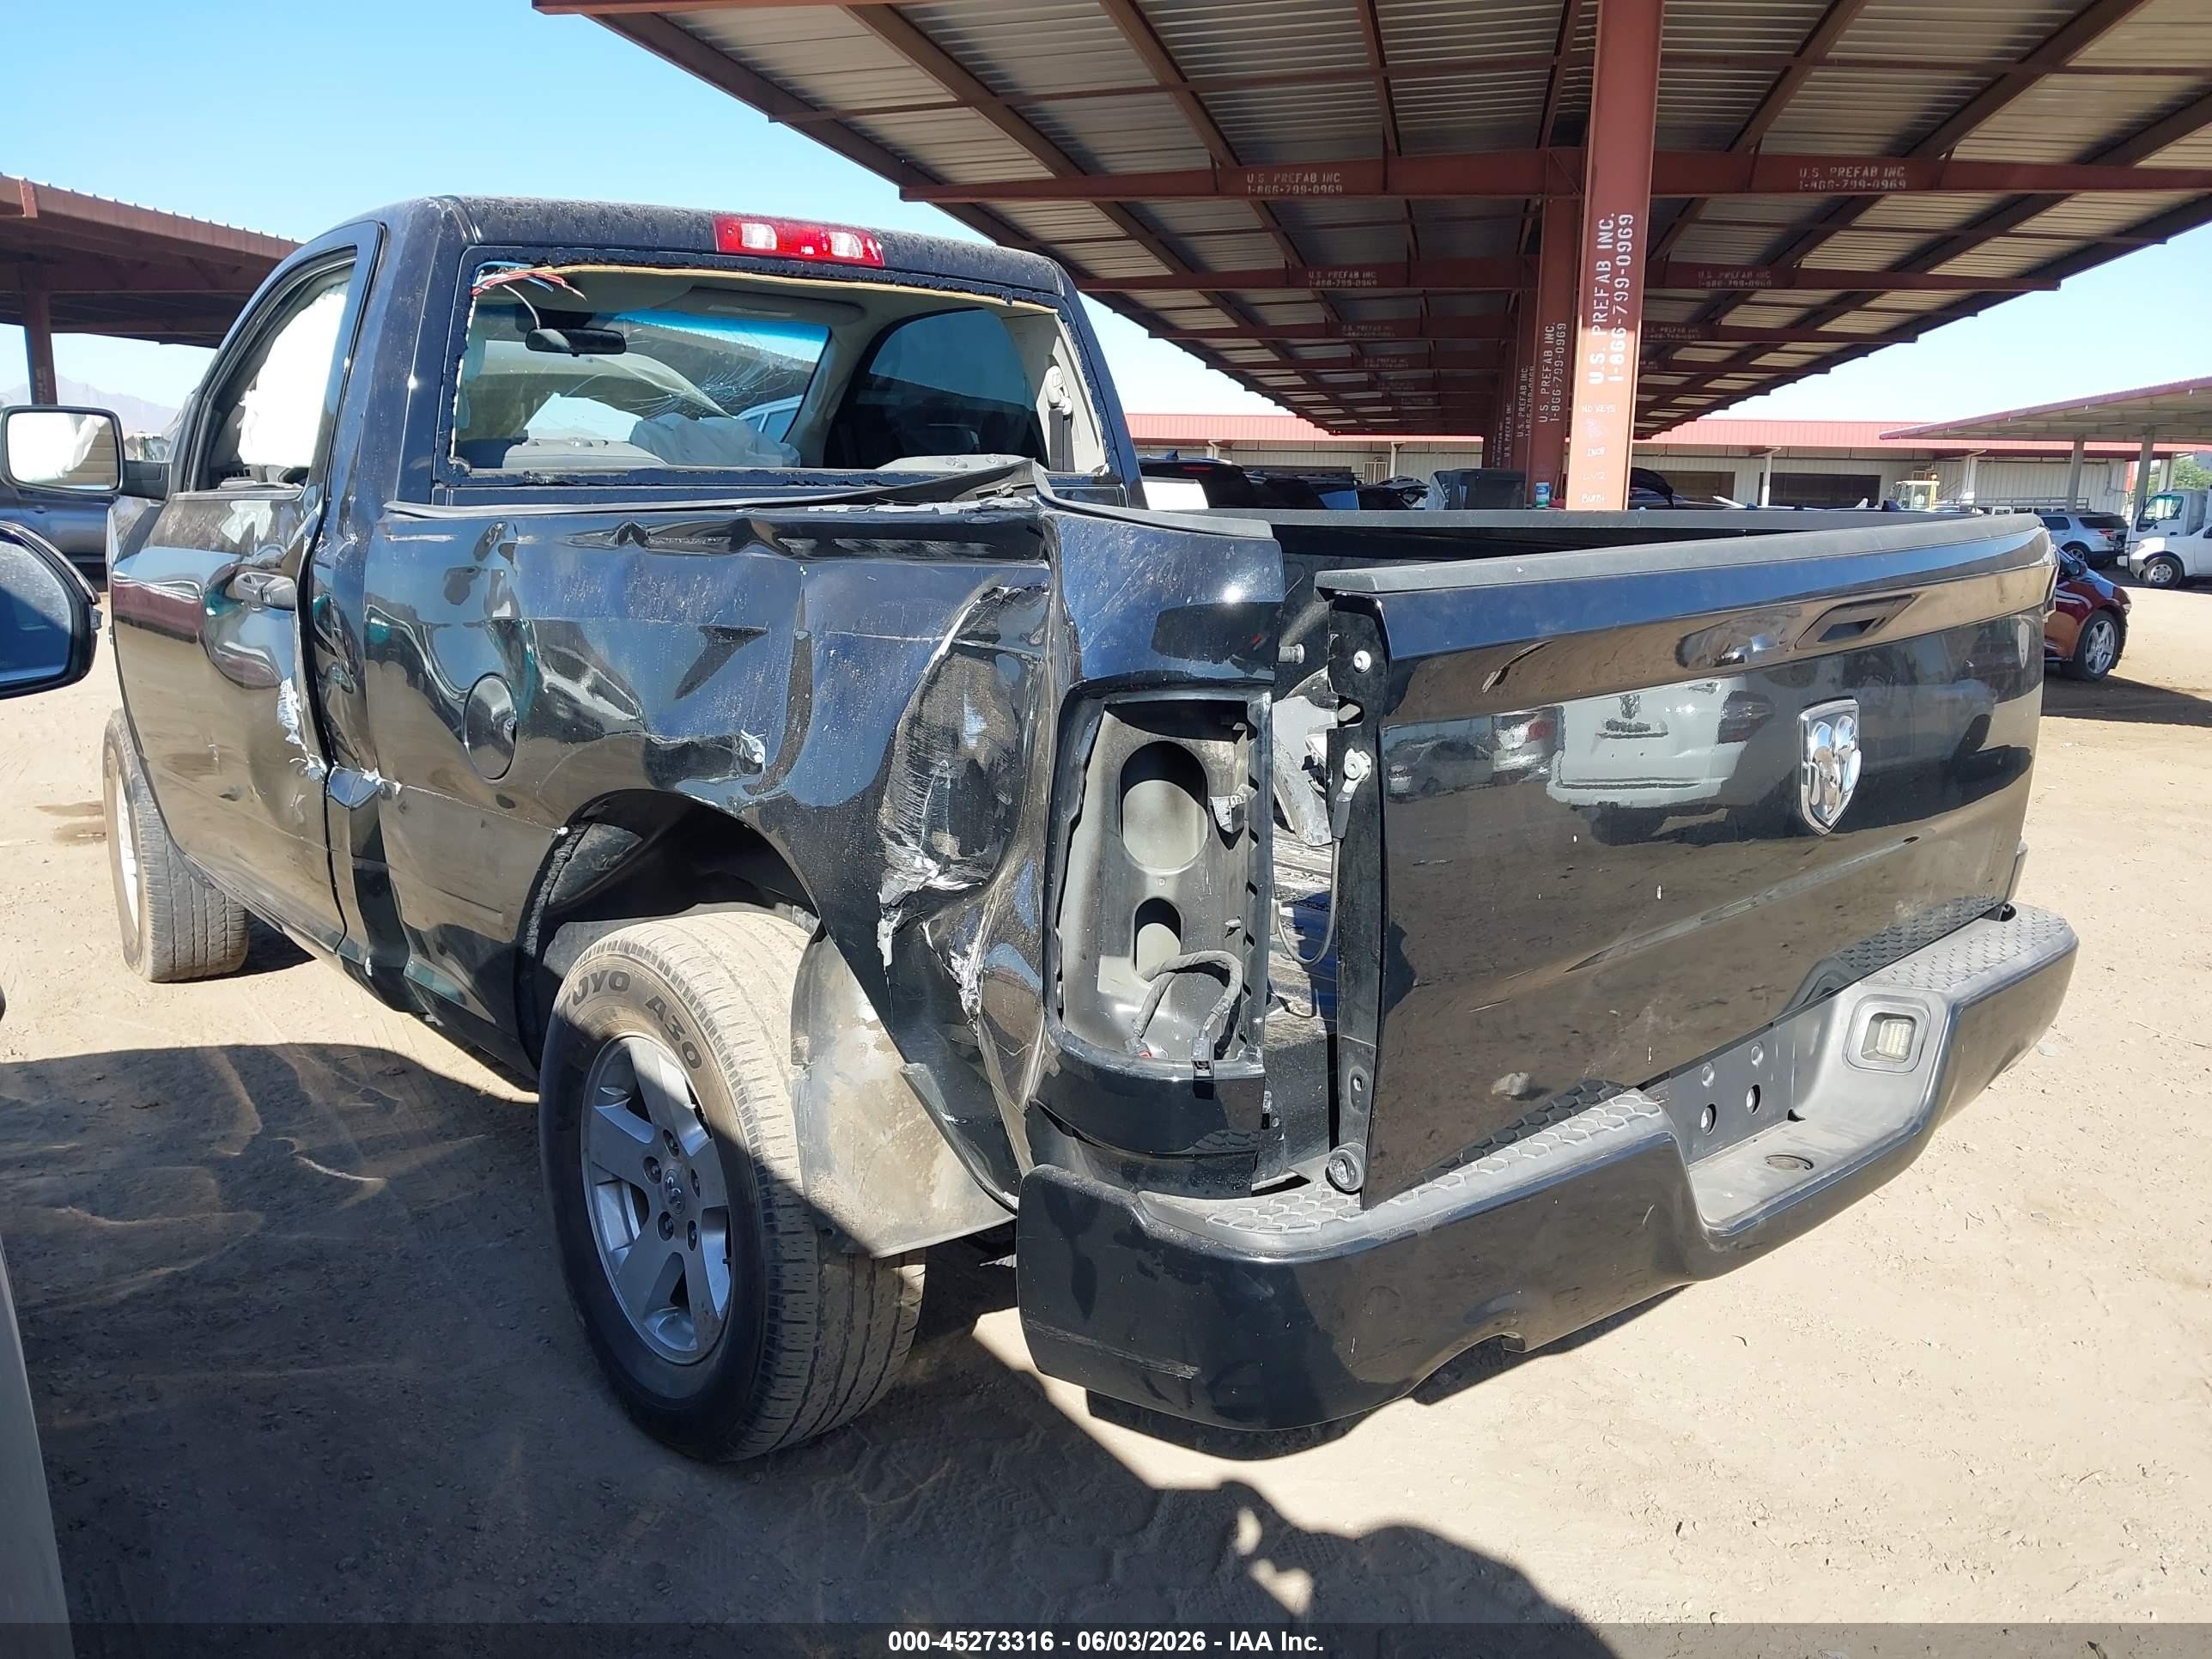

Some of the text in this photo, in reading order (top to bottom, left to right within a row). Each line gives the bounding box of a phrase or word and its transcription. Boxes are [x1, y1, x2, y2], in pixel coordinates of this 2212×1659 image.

[1273, 172, 1318, 183] PREFAB
[1829, 166, 1878, 178] PREFAB
[1597, 213, 1614, 249] INC.
[1591, 259, 1612, 337] PREFAB
[1607, 214, 1634, 382] 1-866-799-0969
[1540, 349, 1553, 394] PREFAB
[1549, 323, 1566, 422] 1-866-799-0969
[645, 994, 703, 1071] A30
